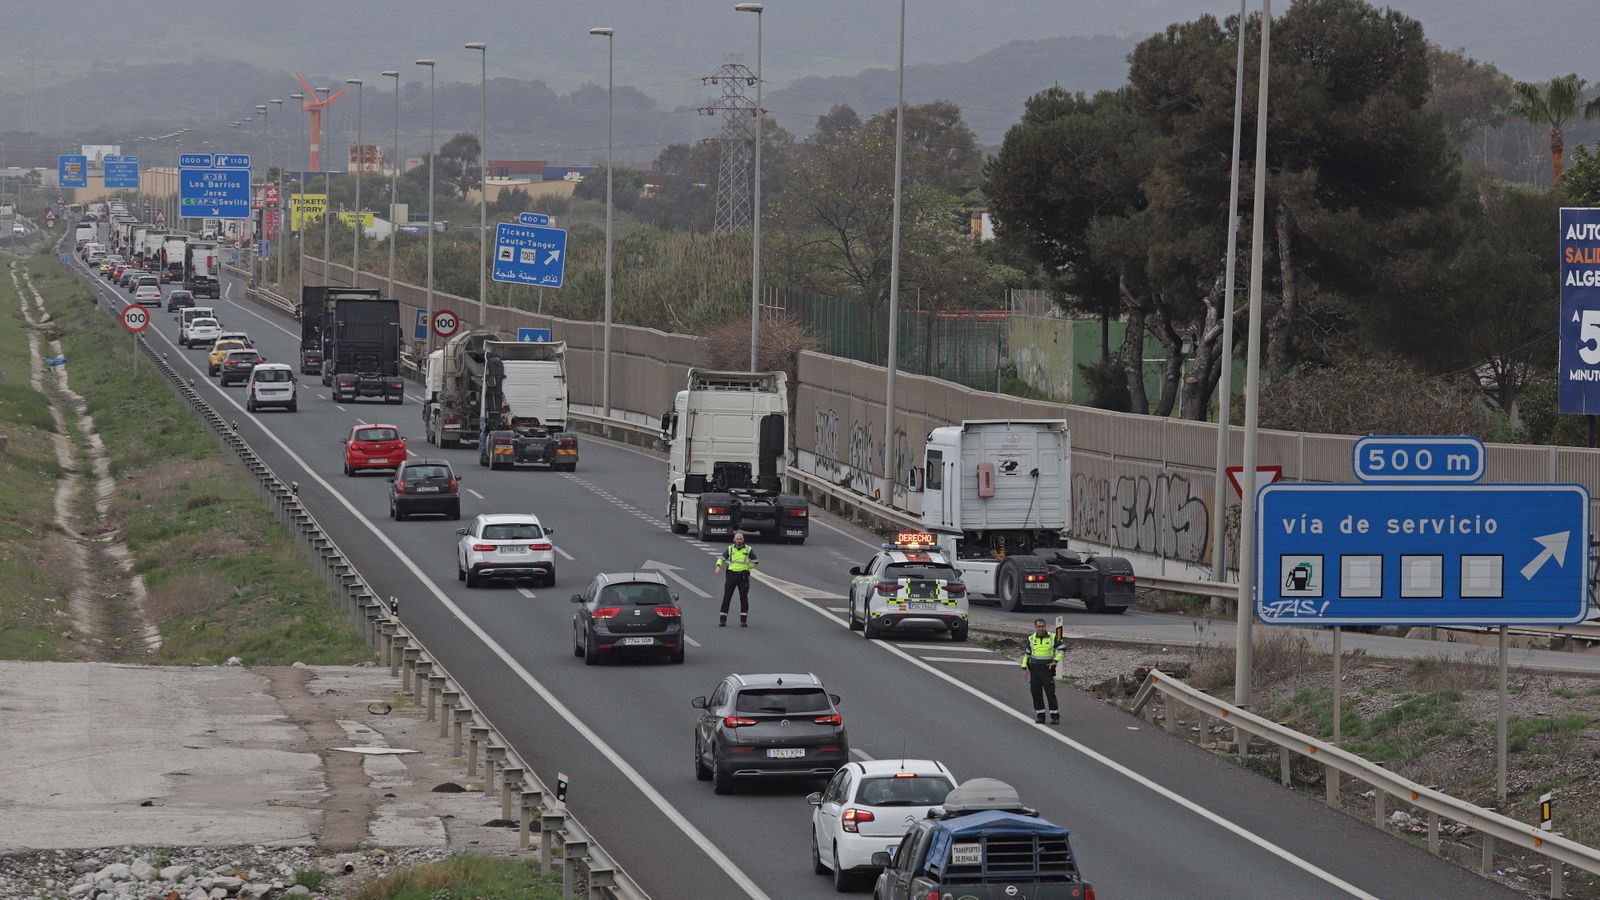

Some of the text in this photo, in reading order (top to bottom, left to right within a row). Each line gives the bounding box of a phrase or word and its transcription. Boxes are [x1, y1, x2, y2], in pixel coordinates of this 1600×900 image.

[218, 198, 248, 206] Sevilla
[501, 228, 535, 238] Tickets
[500, 237, 556, 249] Ceuta-Tanger
[126, 313, 146, 323] 100
[1572, 309, 1580, 322] A
[436, 318, 455, 328] 100
[1569, 369, 1600, 382] MINUT
[1368, 449, 1471, 471] 500 m
[1282, 513, 1498, 535] vía de servicio
[898, 533, 932, 542] DERECHO
